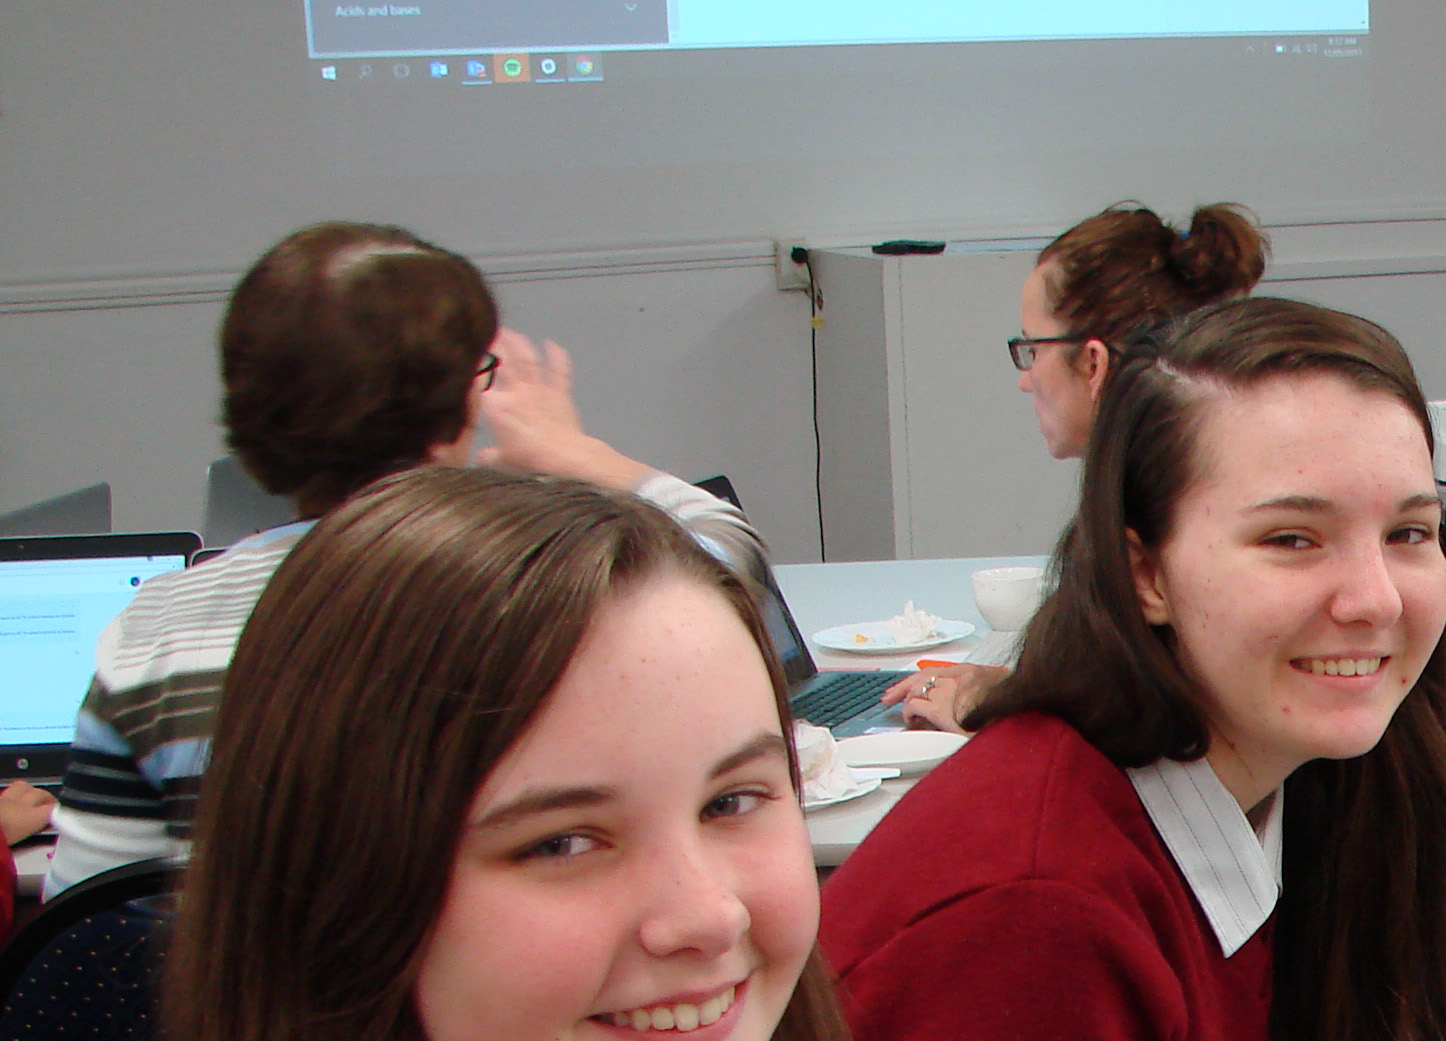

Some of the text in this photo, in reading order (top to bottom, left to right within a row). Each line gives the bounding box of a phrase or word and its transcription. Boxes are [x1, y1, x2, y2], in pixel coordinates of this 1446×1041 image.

[335, 4, 422, 18] Acids and bases
